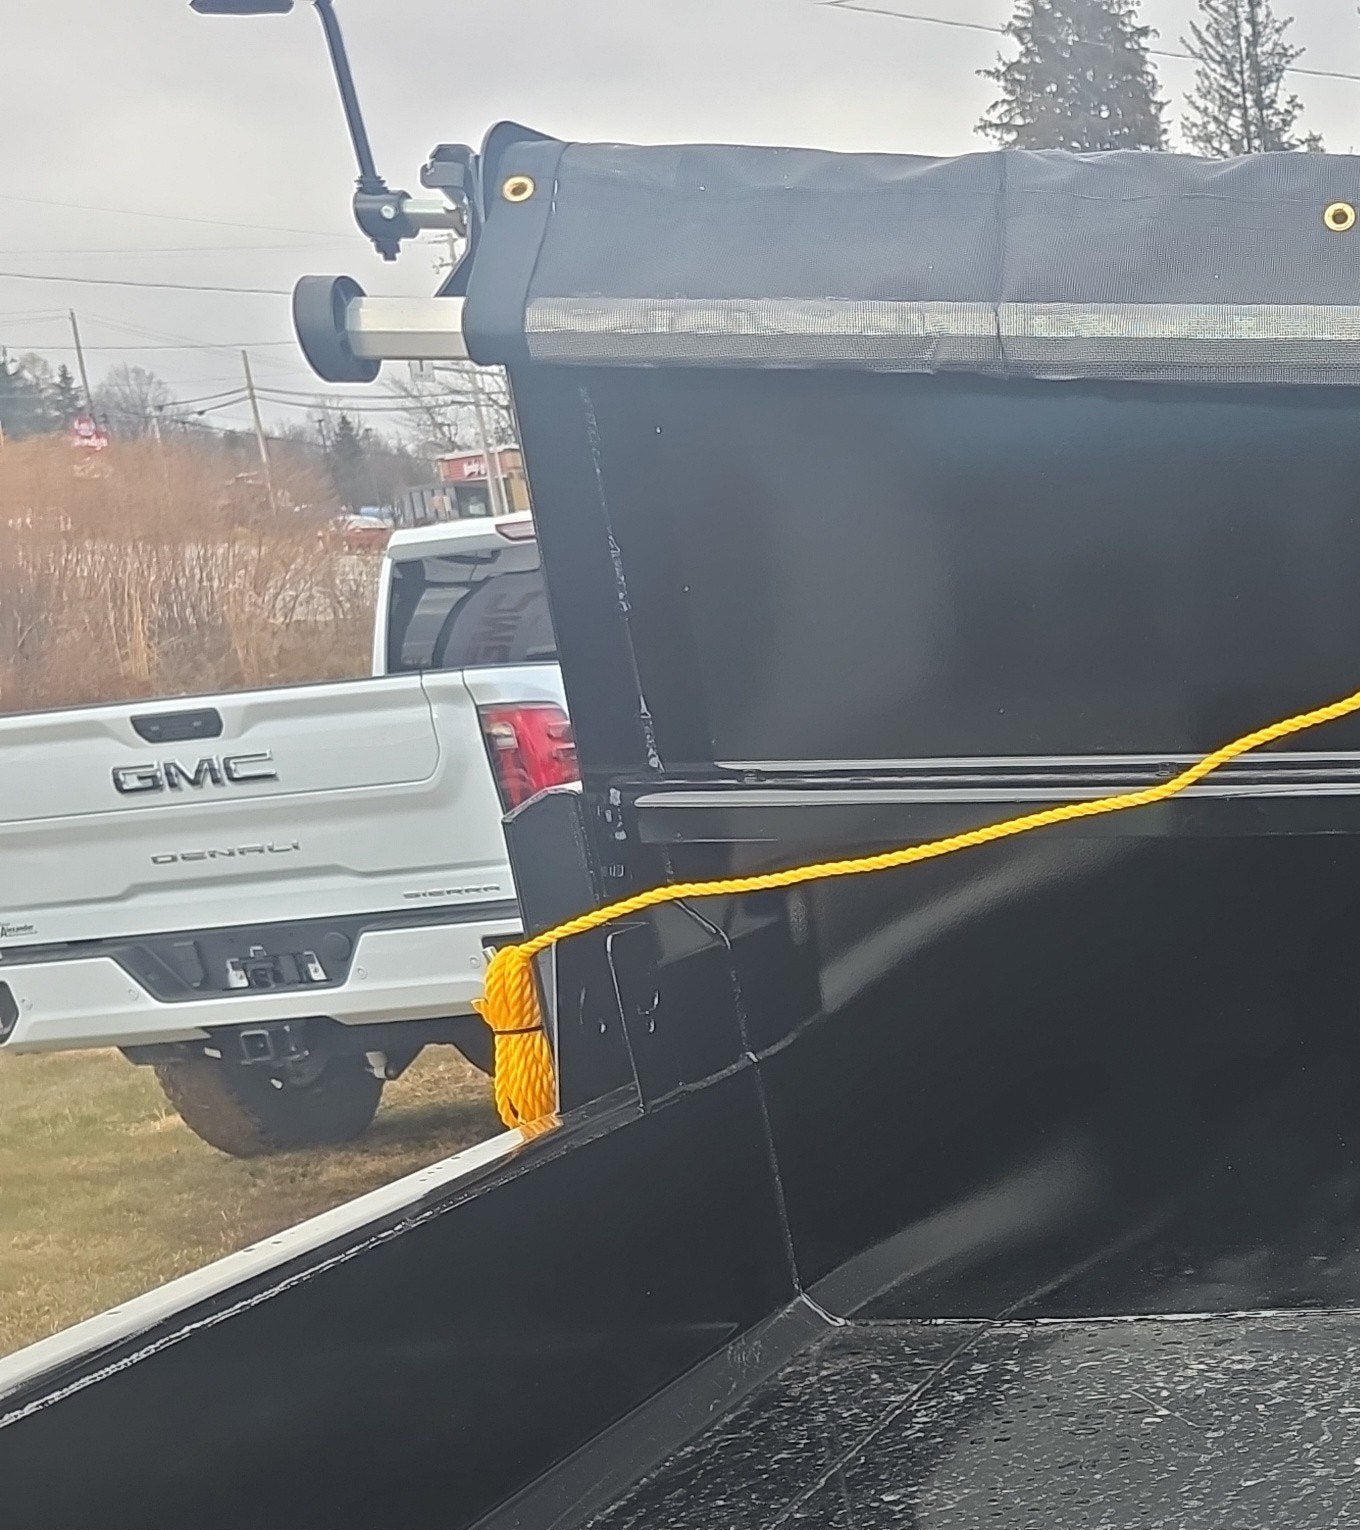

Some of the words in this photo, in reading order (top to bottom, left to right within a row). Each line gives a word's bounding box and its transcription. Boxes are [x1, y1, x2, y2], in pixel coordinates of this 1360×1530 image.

[112, 750, 280, 795] GMC
[151, 841, 300, 865] DENALI
[403, 884, 501, 900] SIERRA
